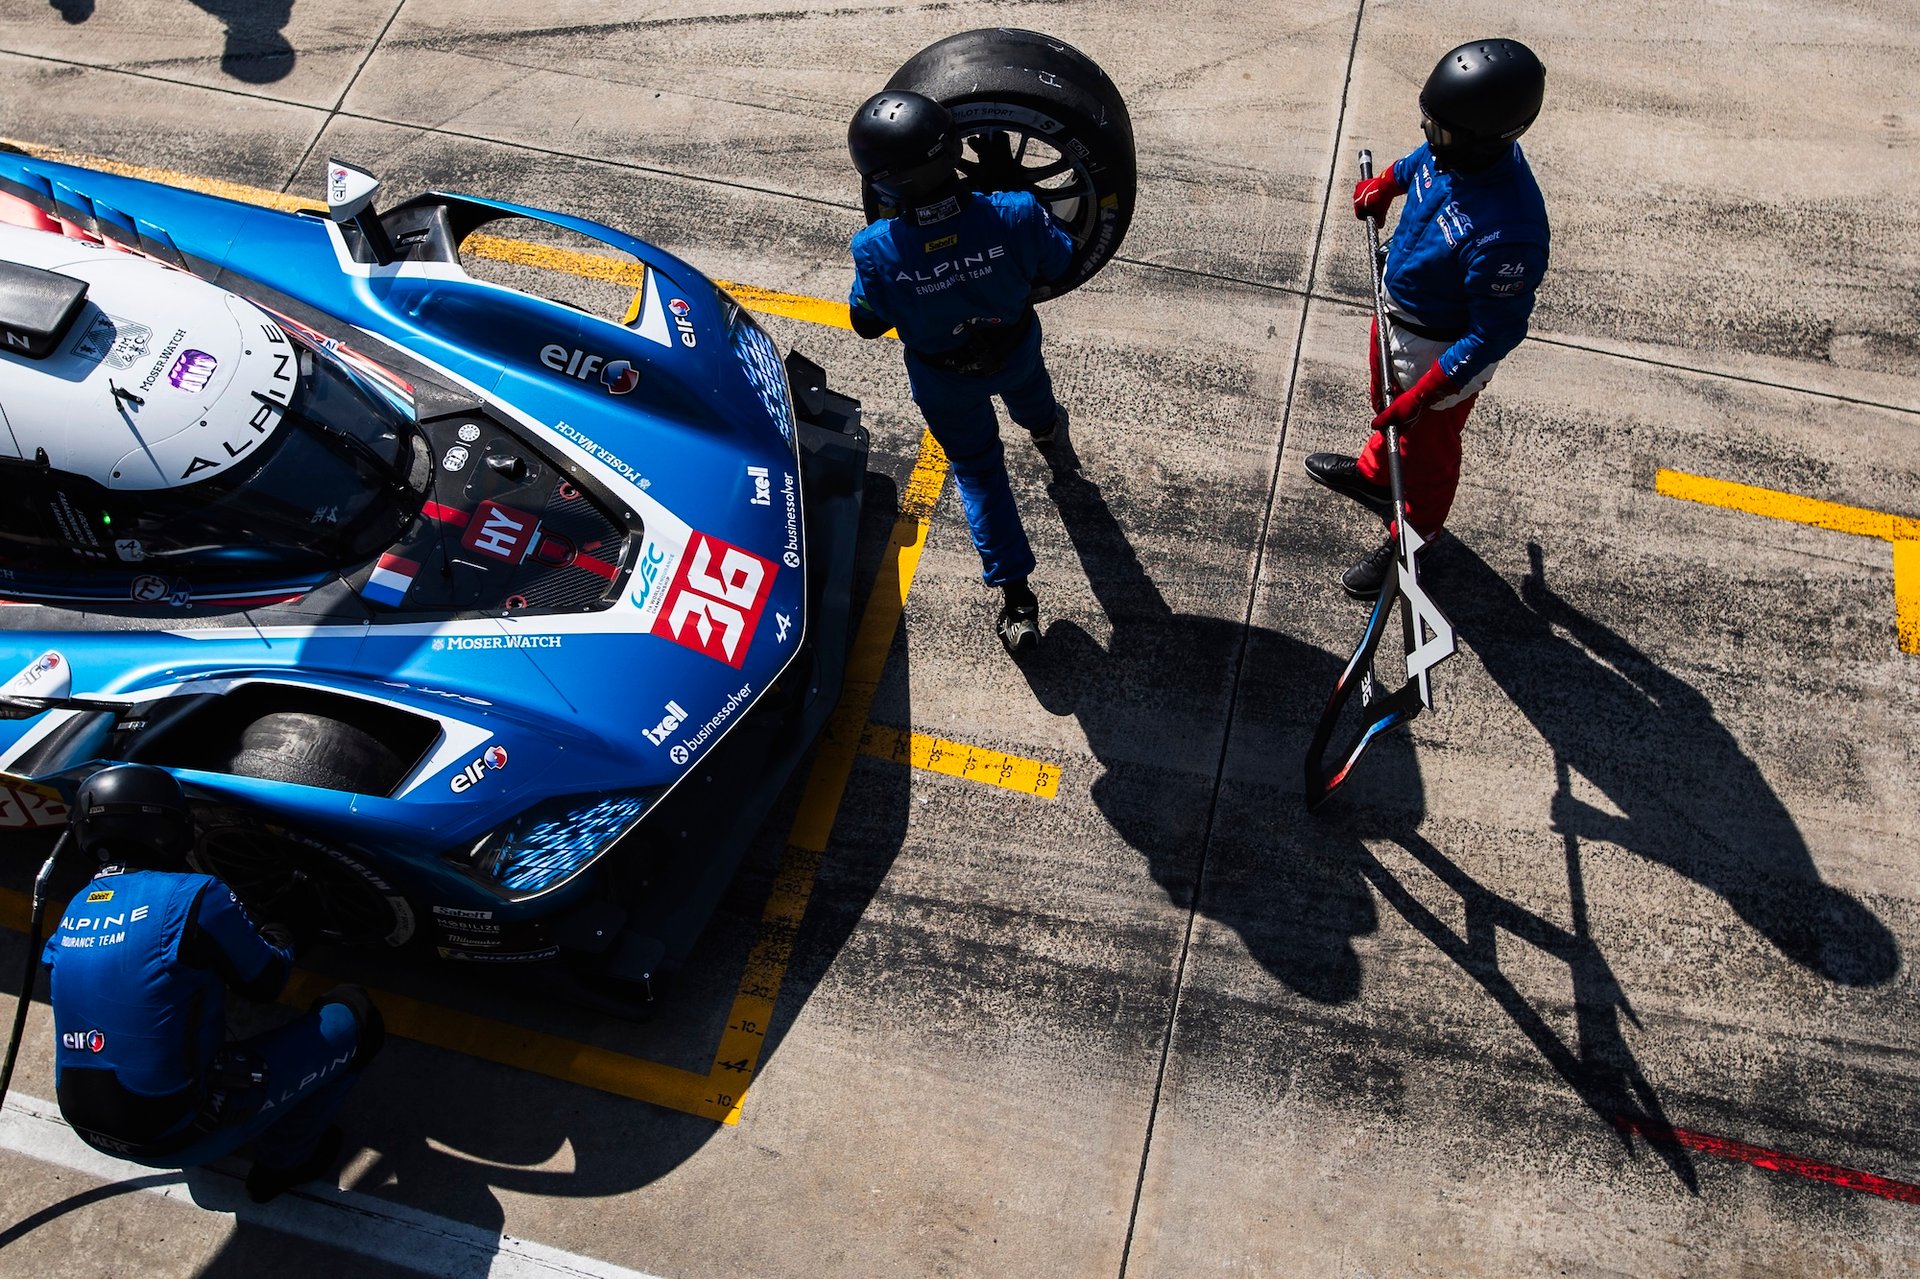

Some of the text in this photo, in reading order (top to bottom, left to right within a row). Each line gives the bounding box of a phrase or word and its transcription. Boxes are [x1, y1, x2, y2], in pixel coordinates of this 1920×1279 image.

[981, 108, 1015, 117] SPORT
[332, 180, 346, 202] elf
[928, 236, 956, 249] Sabelt
[896, 245, 1004, 282] ALPINE
[916, 265, 993, 295] ENDURANCE TEAM
[680, 316, 697, 349] elf
[139, 329, 187, 392] MOSER.WATCH
[540, 343, 603, 381] elf
[181, 325, 291, 479] ALPINE
[554, 420, 641, 480] MOSER.WATCH
[747, 466, 771, 506] ixell
[782, 472, 797, 550] businessolver
[474, 507, 524, 557] HY
[631, 542, 664, 609] WEC
[668, 535, 765, 662] 36
[447, 636, 561, 650] MOSER.WATCH
[642, 700, 688, 747] ixell
[688, 683, 752, 751] businessolver
[450, 758, 486, 794] elf
[61, 905, 149, 930] ALPINE
[440, 908, 486, 919] Sabelt
[99, 931, 125, 947] TEAM
[63, 1032, 87, 1049] elf
